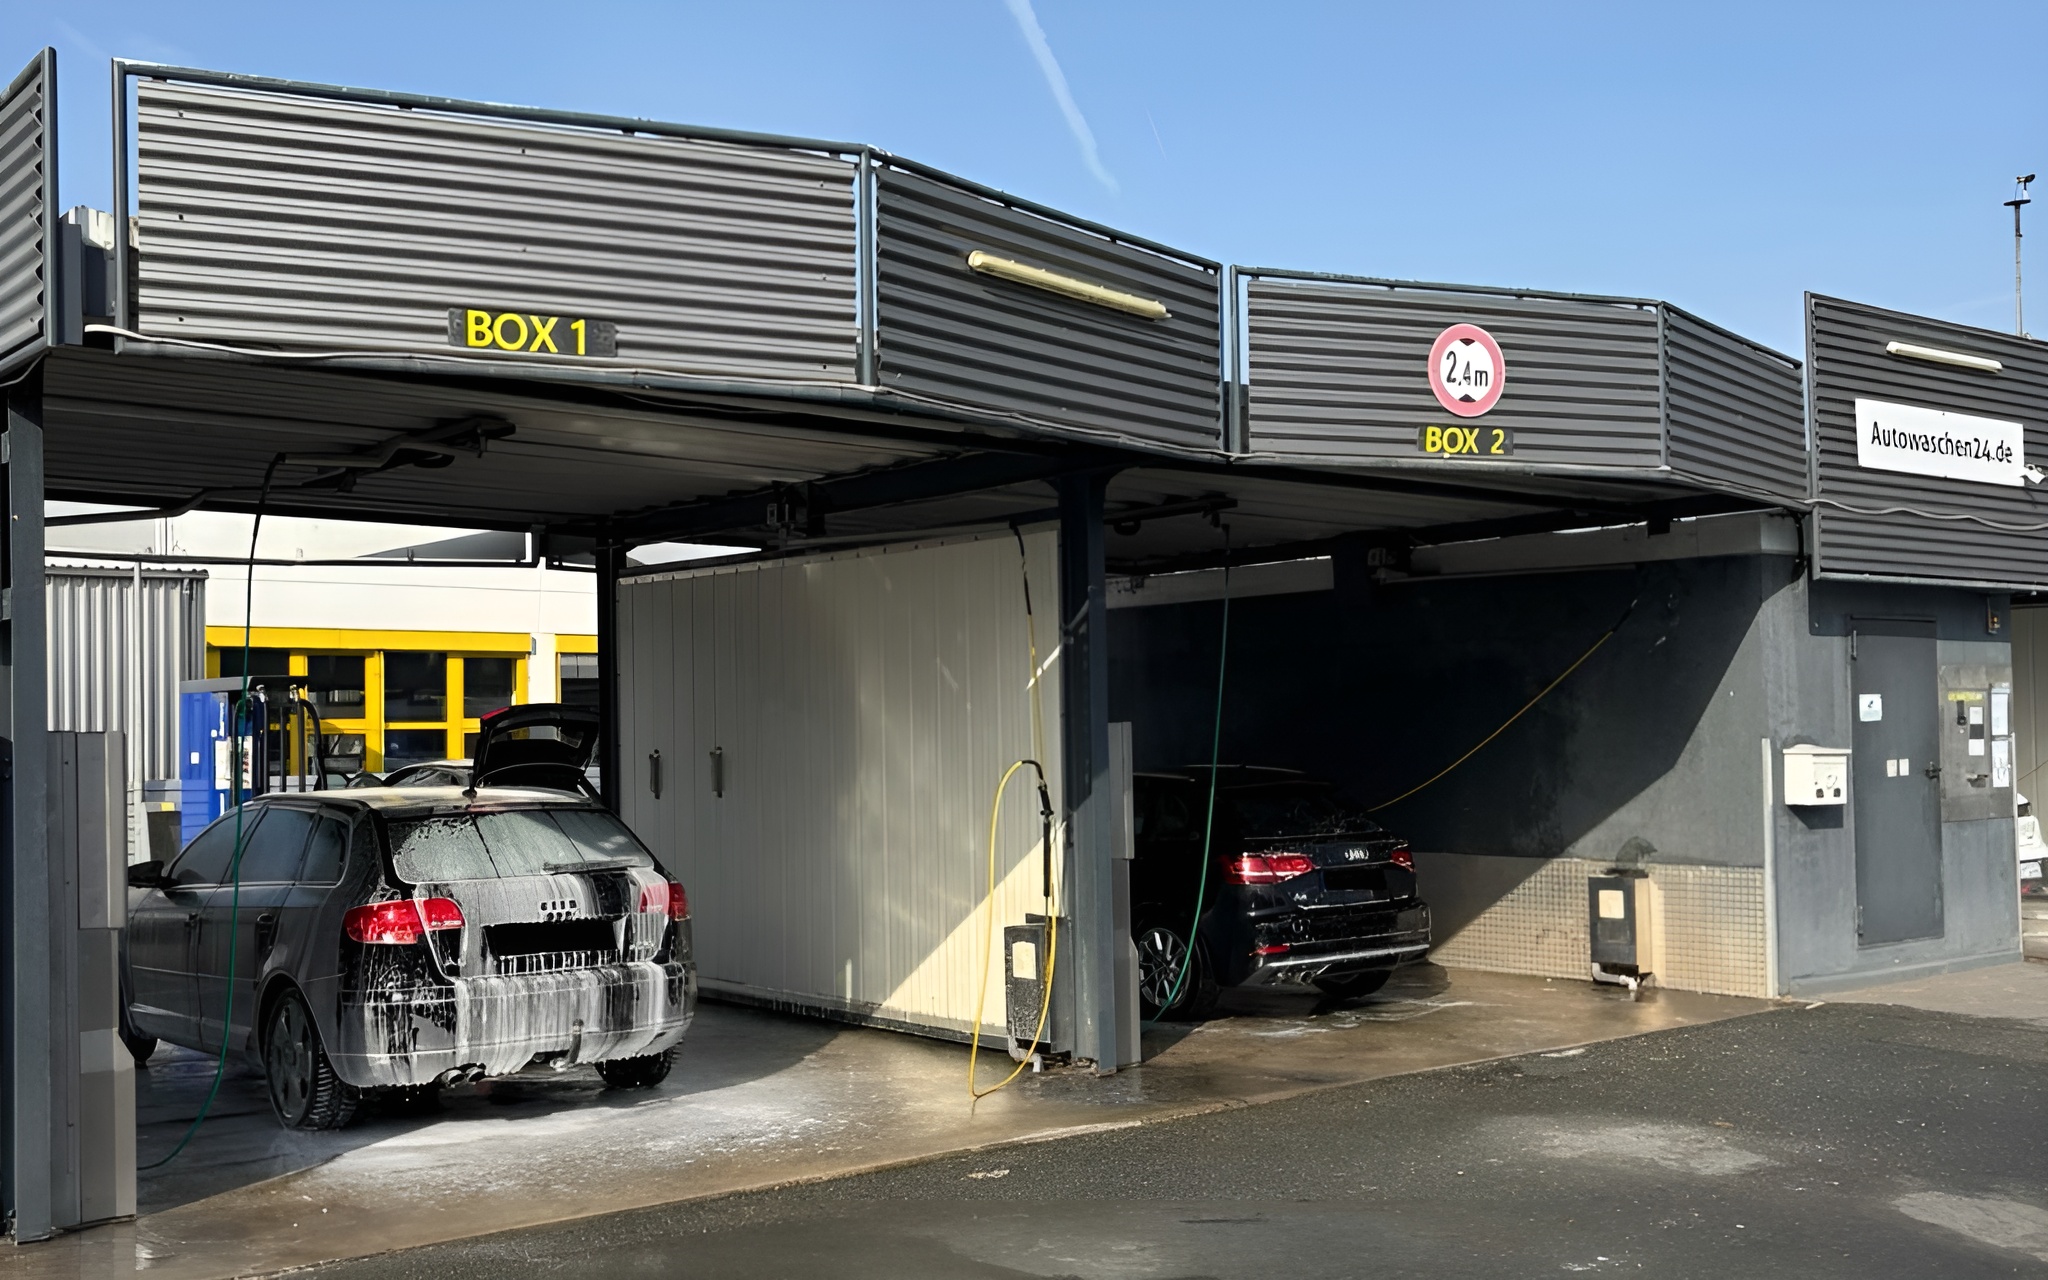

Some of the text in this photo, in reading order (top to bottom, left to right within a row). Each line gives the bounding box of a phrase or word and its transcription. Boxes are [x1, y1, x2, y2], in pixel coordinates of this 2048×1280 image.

[466, 309, 586, 356] BOX 1
[1425, 425, 1505, 455] BOX 2
[1871, 421, 2013, 464] Autowaschen24.de
